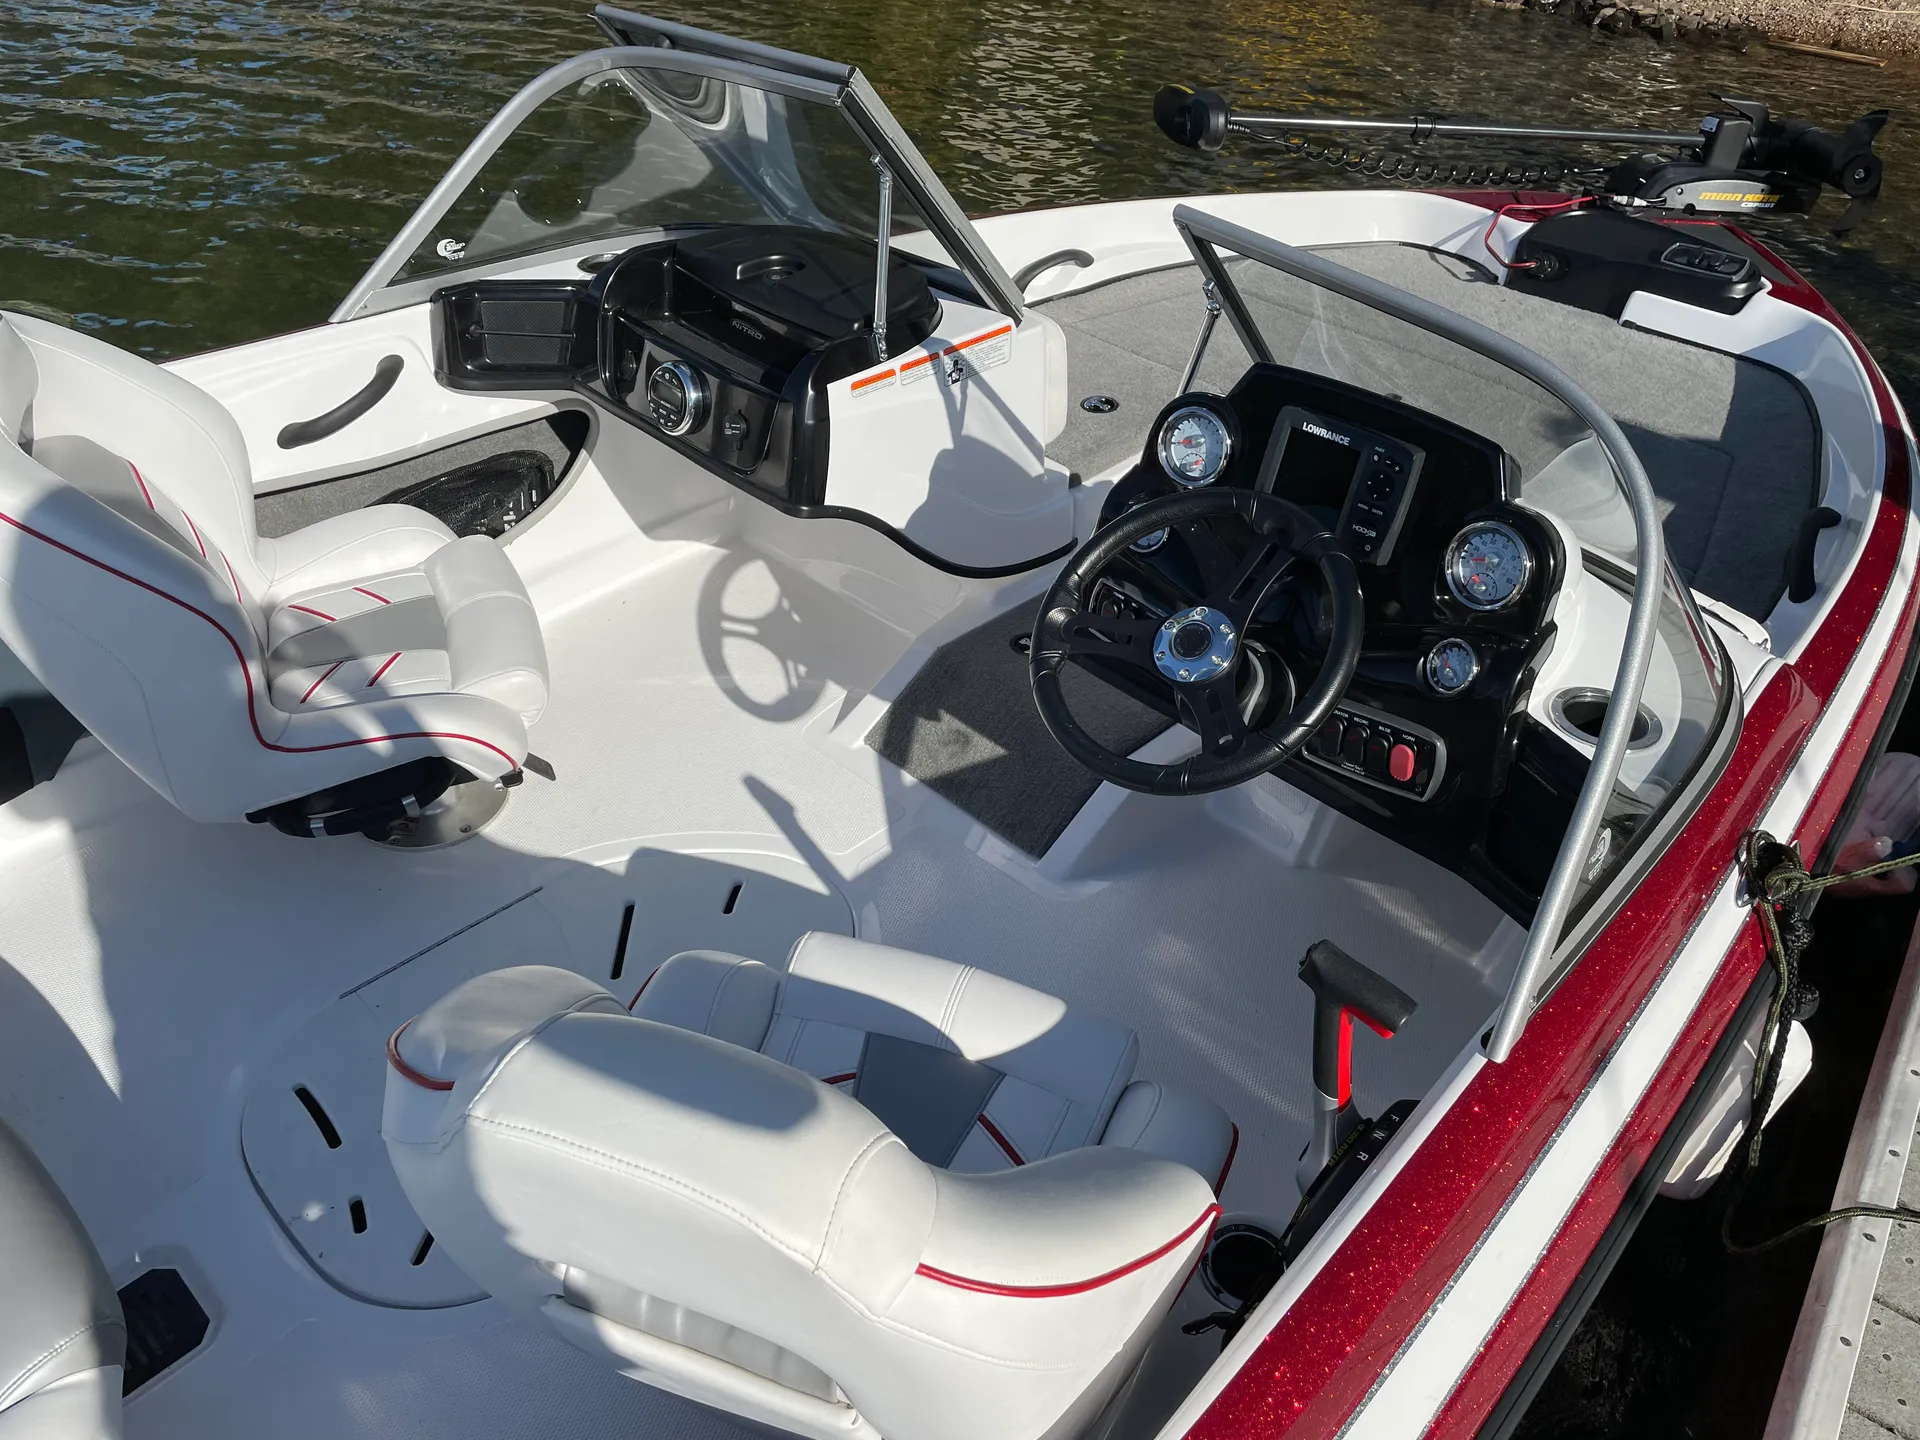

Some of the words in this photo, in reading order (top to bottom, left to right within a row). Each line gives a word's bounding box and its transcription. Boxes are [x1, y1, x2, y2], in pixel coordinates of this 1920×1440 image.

[732, 321, 762, 340] NITRO
[1302, 421, 1351, 446] LOWRANCE
[1390, 1114, 1400, 1123] F
[1373, 1130, 1385, 1140] N
[1356, 1151, 1369, 1162] R
